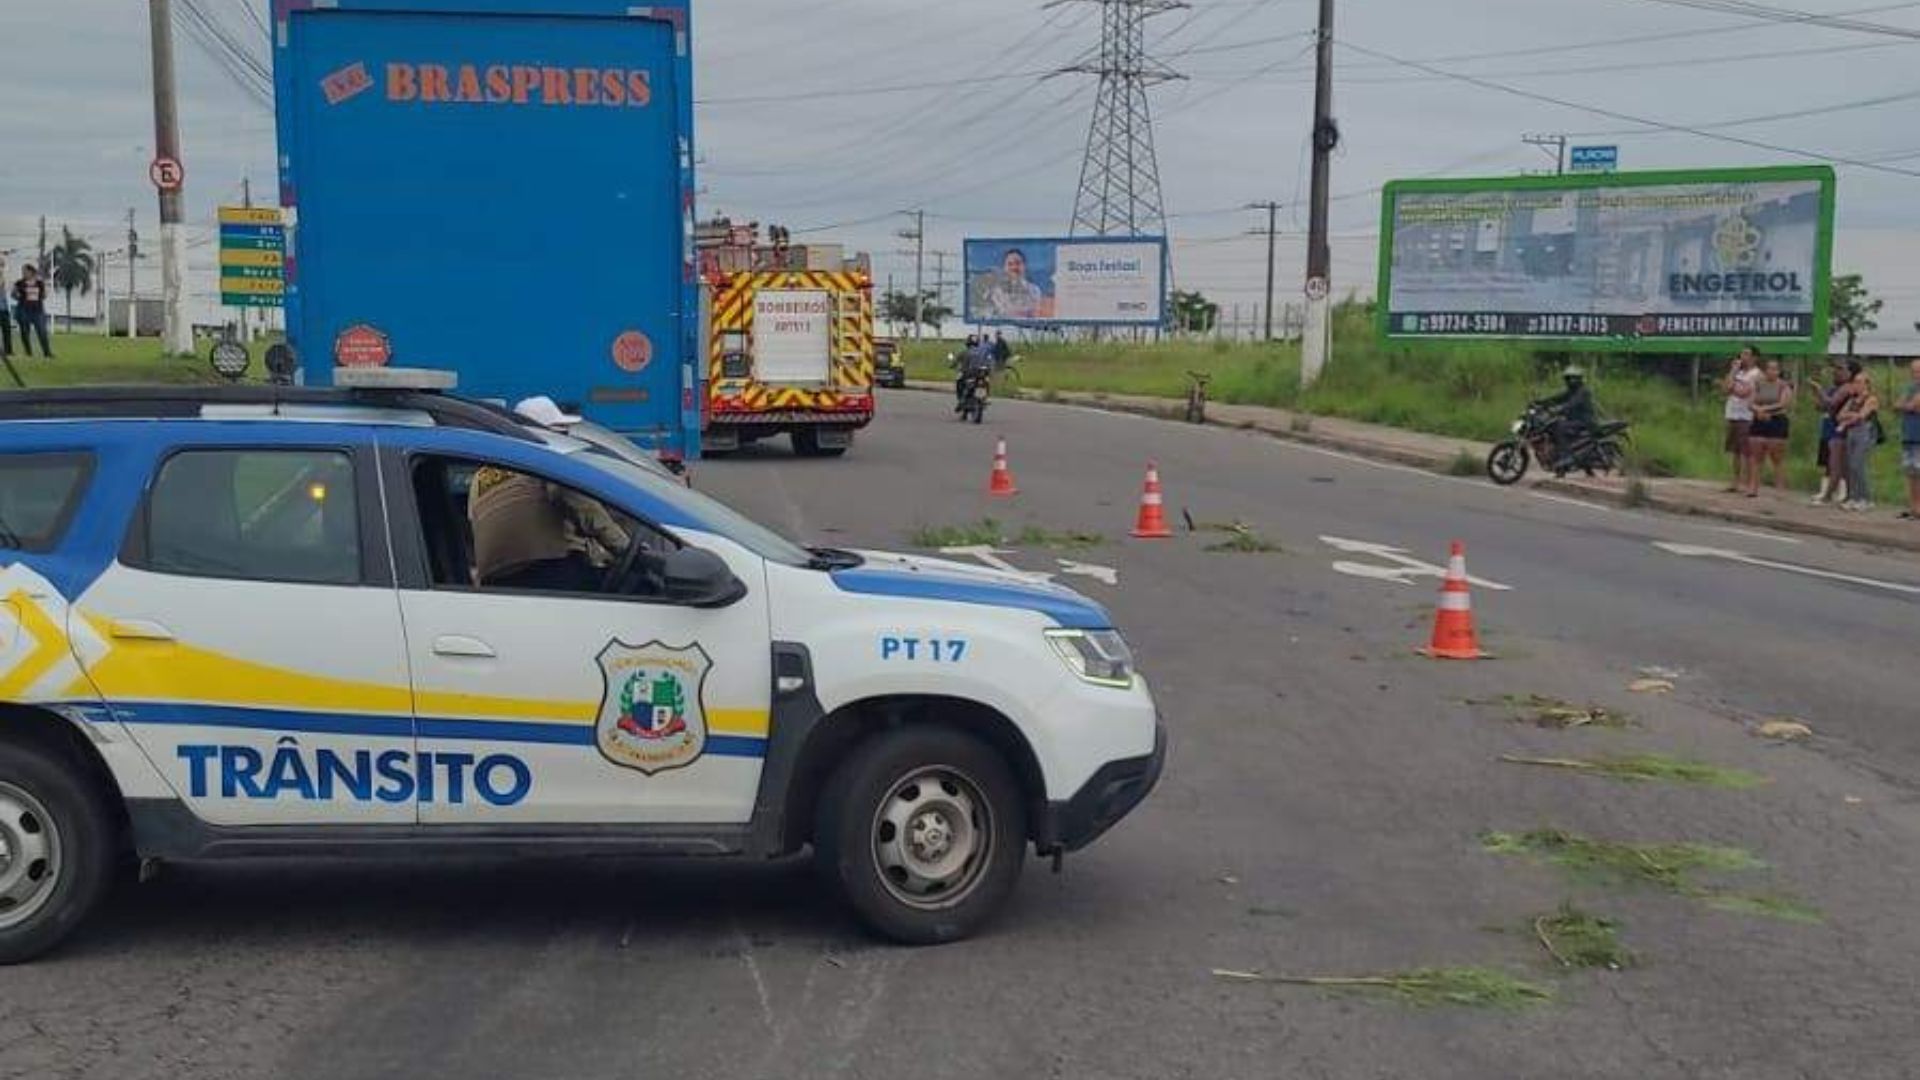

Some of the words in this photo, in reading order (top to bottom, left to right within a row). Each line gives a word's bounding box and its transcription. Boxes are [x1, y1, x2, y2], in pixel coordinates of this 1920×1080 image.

[387, 63, 650, 106] BRASPRESS
[1669, 272, 1802, 293] ENGETROL
[881, 637, 919, 660] PT
[930, 639, 966, 661] 17
[177, 736, 532, 806] TRÂNSITO
